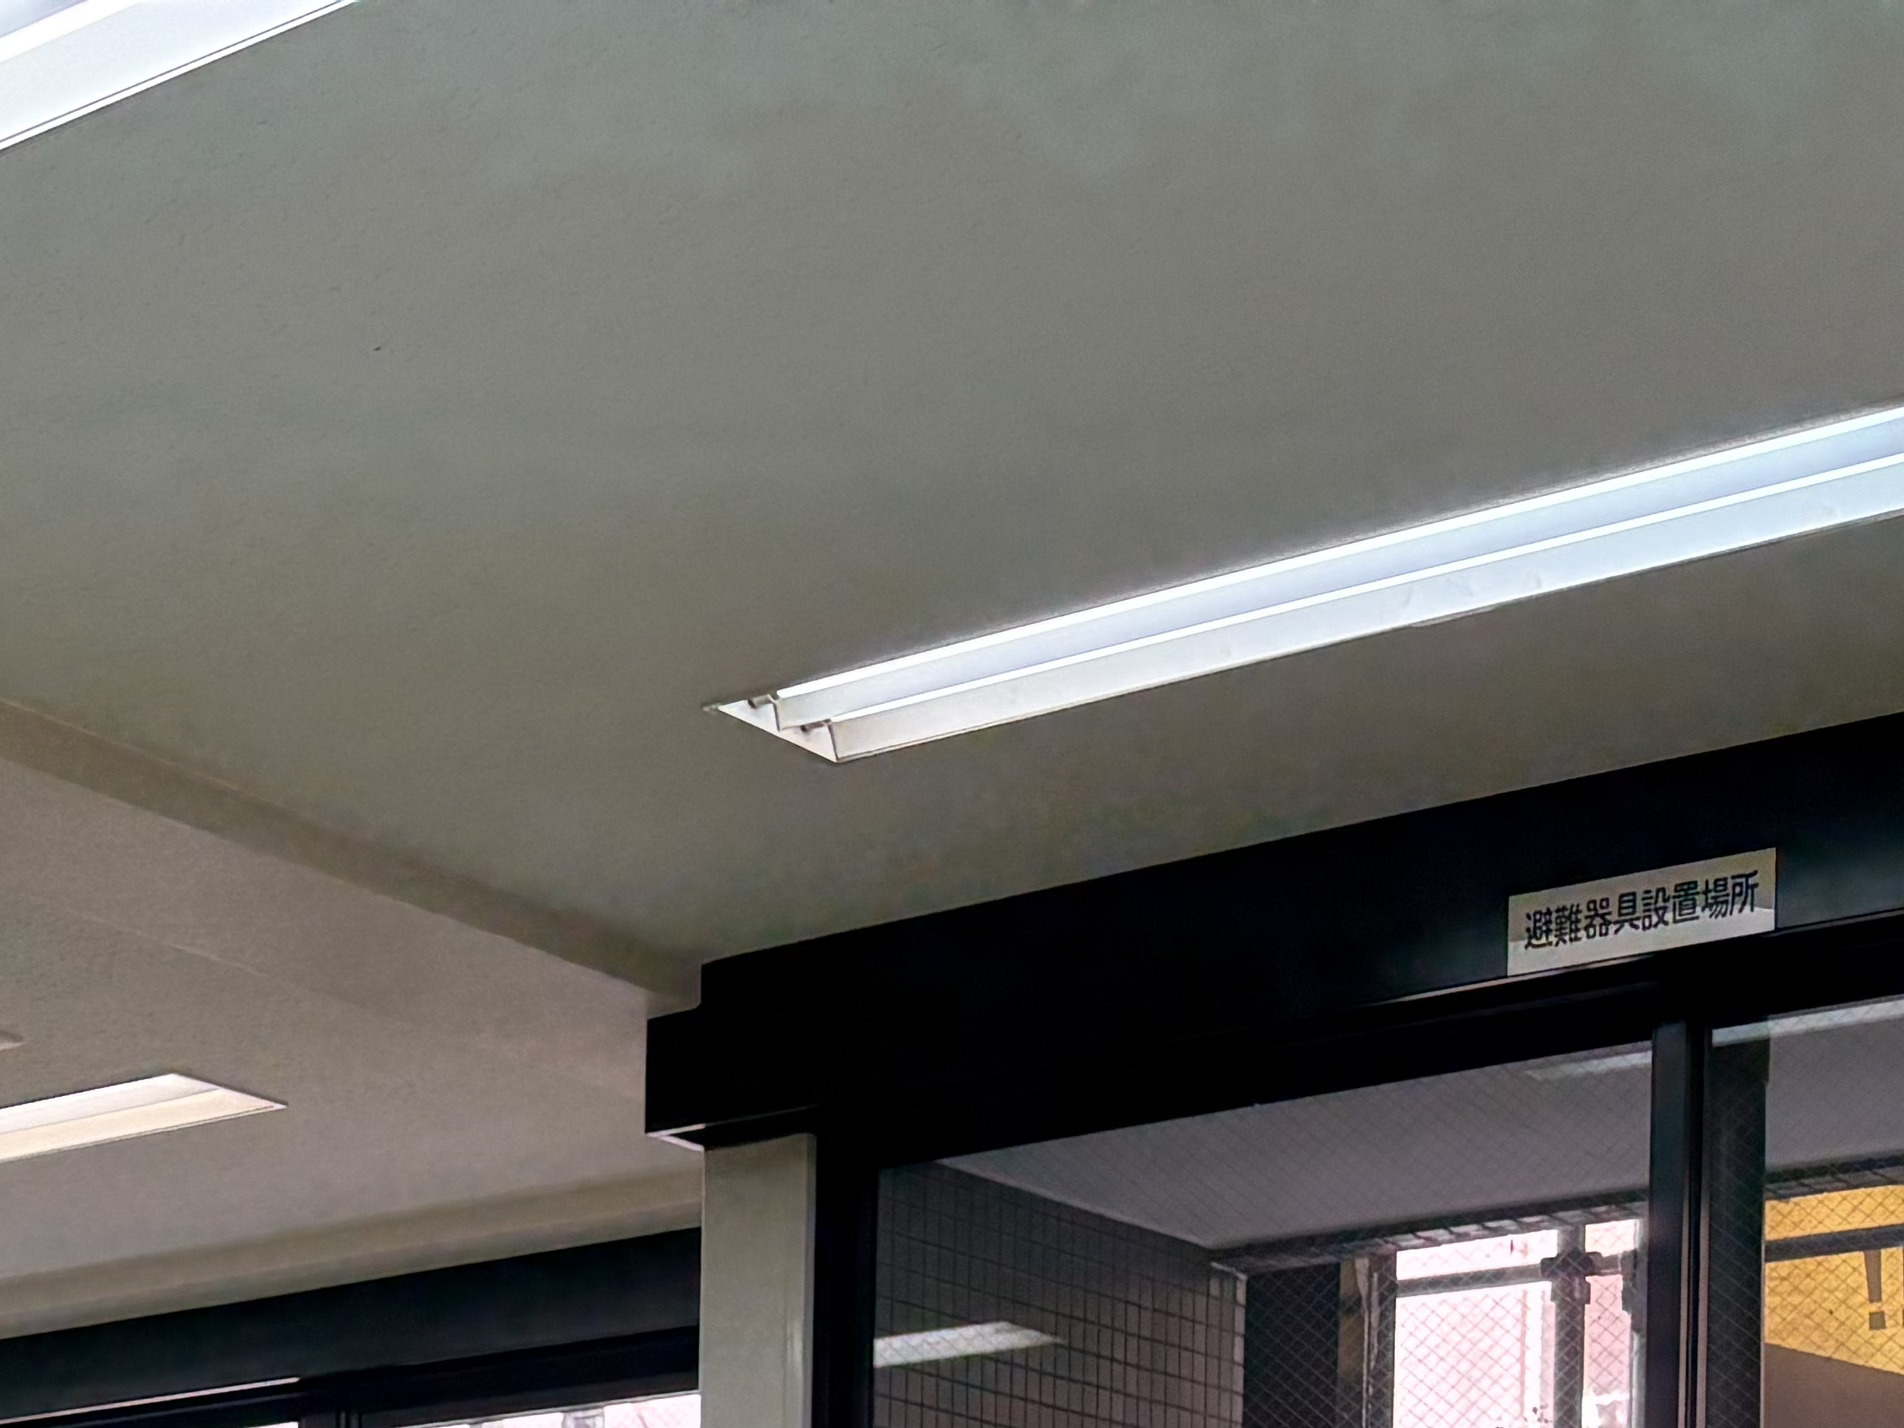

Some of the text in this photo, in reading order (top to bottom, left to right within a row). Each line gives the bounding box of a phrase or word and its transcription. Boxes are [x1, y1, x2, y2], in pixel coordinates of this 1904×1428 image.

[1523, 869, 1759, 950] 避難器具設置場所
